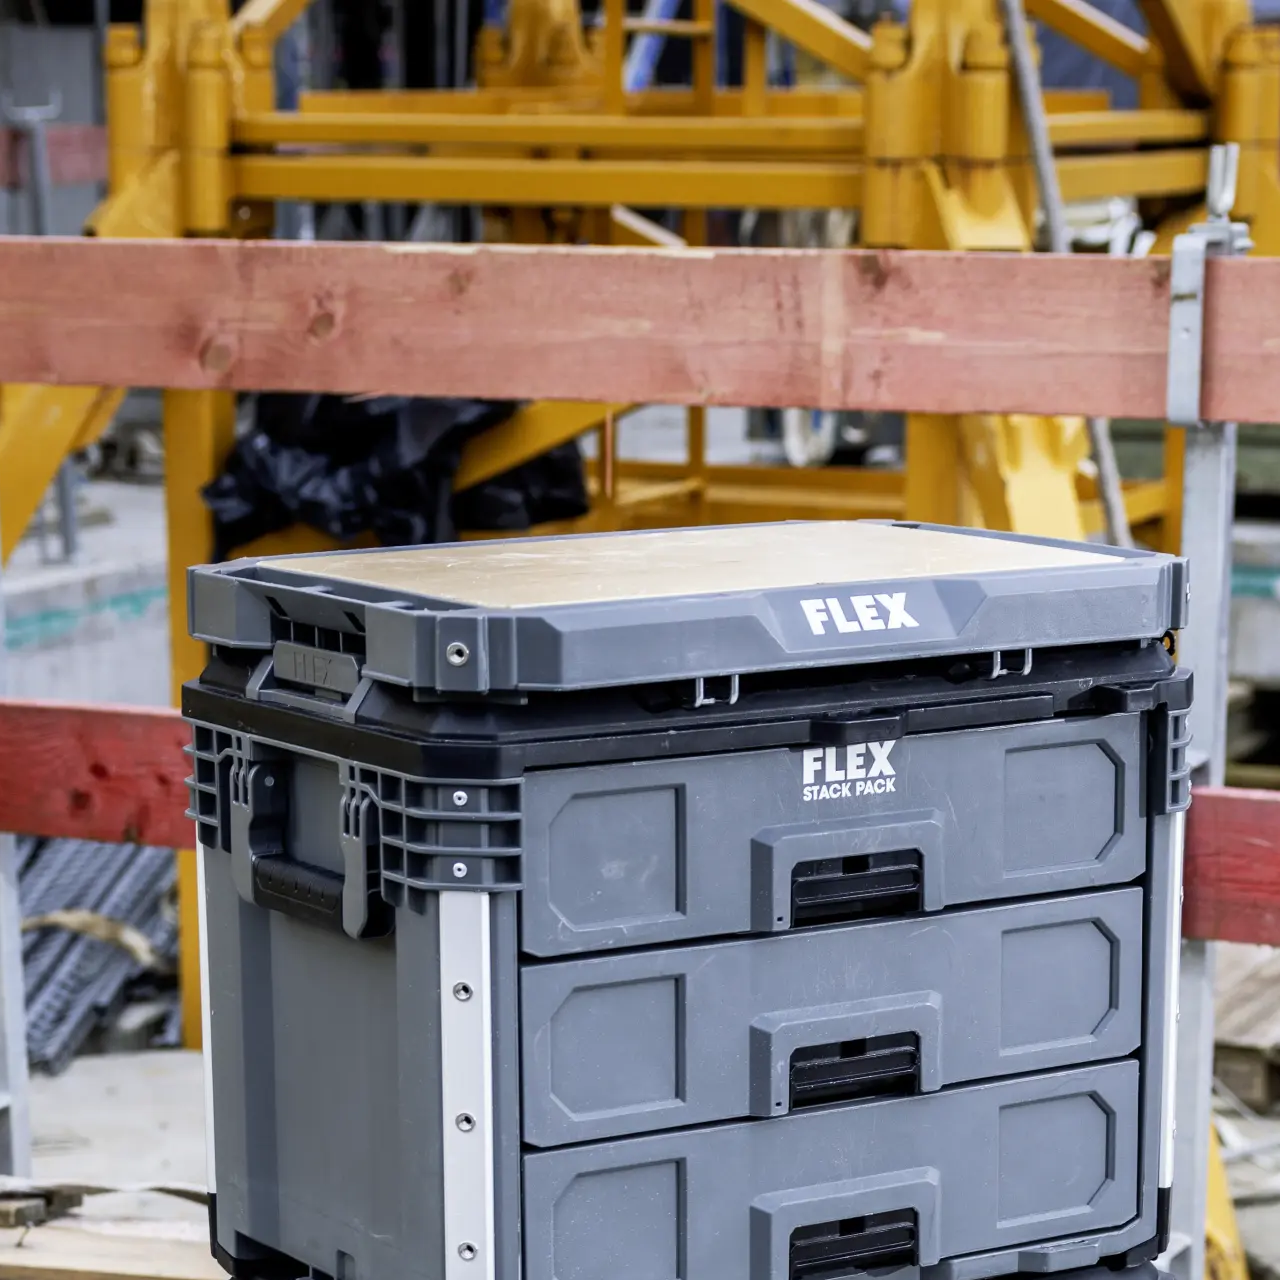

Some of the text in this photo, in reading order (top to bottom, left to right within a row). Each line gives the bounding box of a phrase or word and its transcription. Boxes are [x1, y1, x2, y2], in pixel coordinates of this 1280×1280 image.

[800, 592, 919, 635] FLEX
[803, 739, 896, 785] FLEX
[803, 777, 896, 801] STACK PACK
